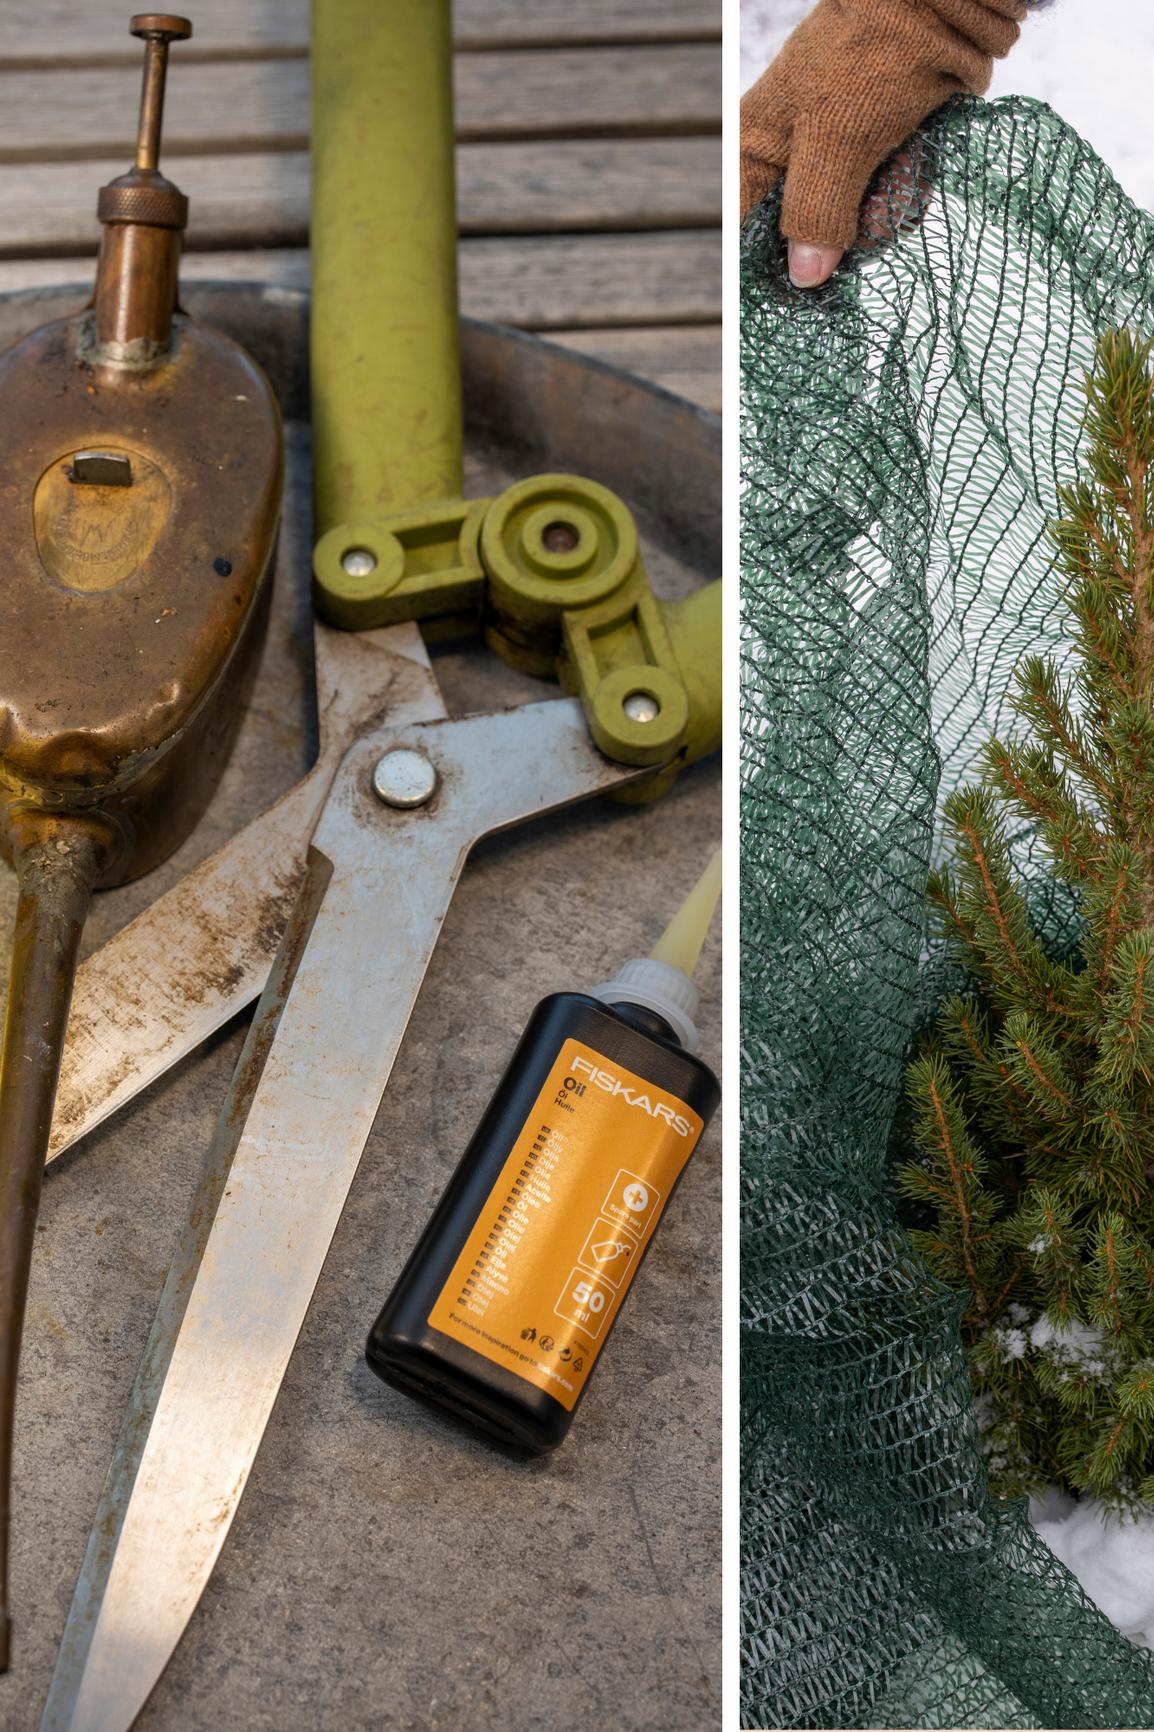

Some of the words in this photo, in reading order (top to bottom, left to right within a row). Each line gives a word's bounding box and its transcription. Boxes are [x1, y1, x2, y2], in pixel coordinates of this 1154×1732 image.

[563, 1076, 587, 1097] Oil
[570, 1056, 690, 1137] FISKARS
[553, 1097, 575, 1113] Huile
[572, 1281, 605, 1313] 50
[574, 1309, 590, 1323] ml
[481, 1331, 520, 1358] inspiration
